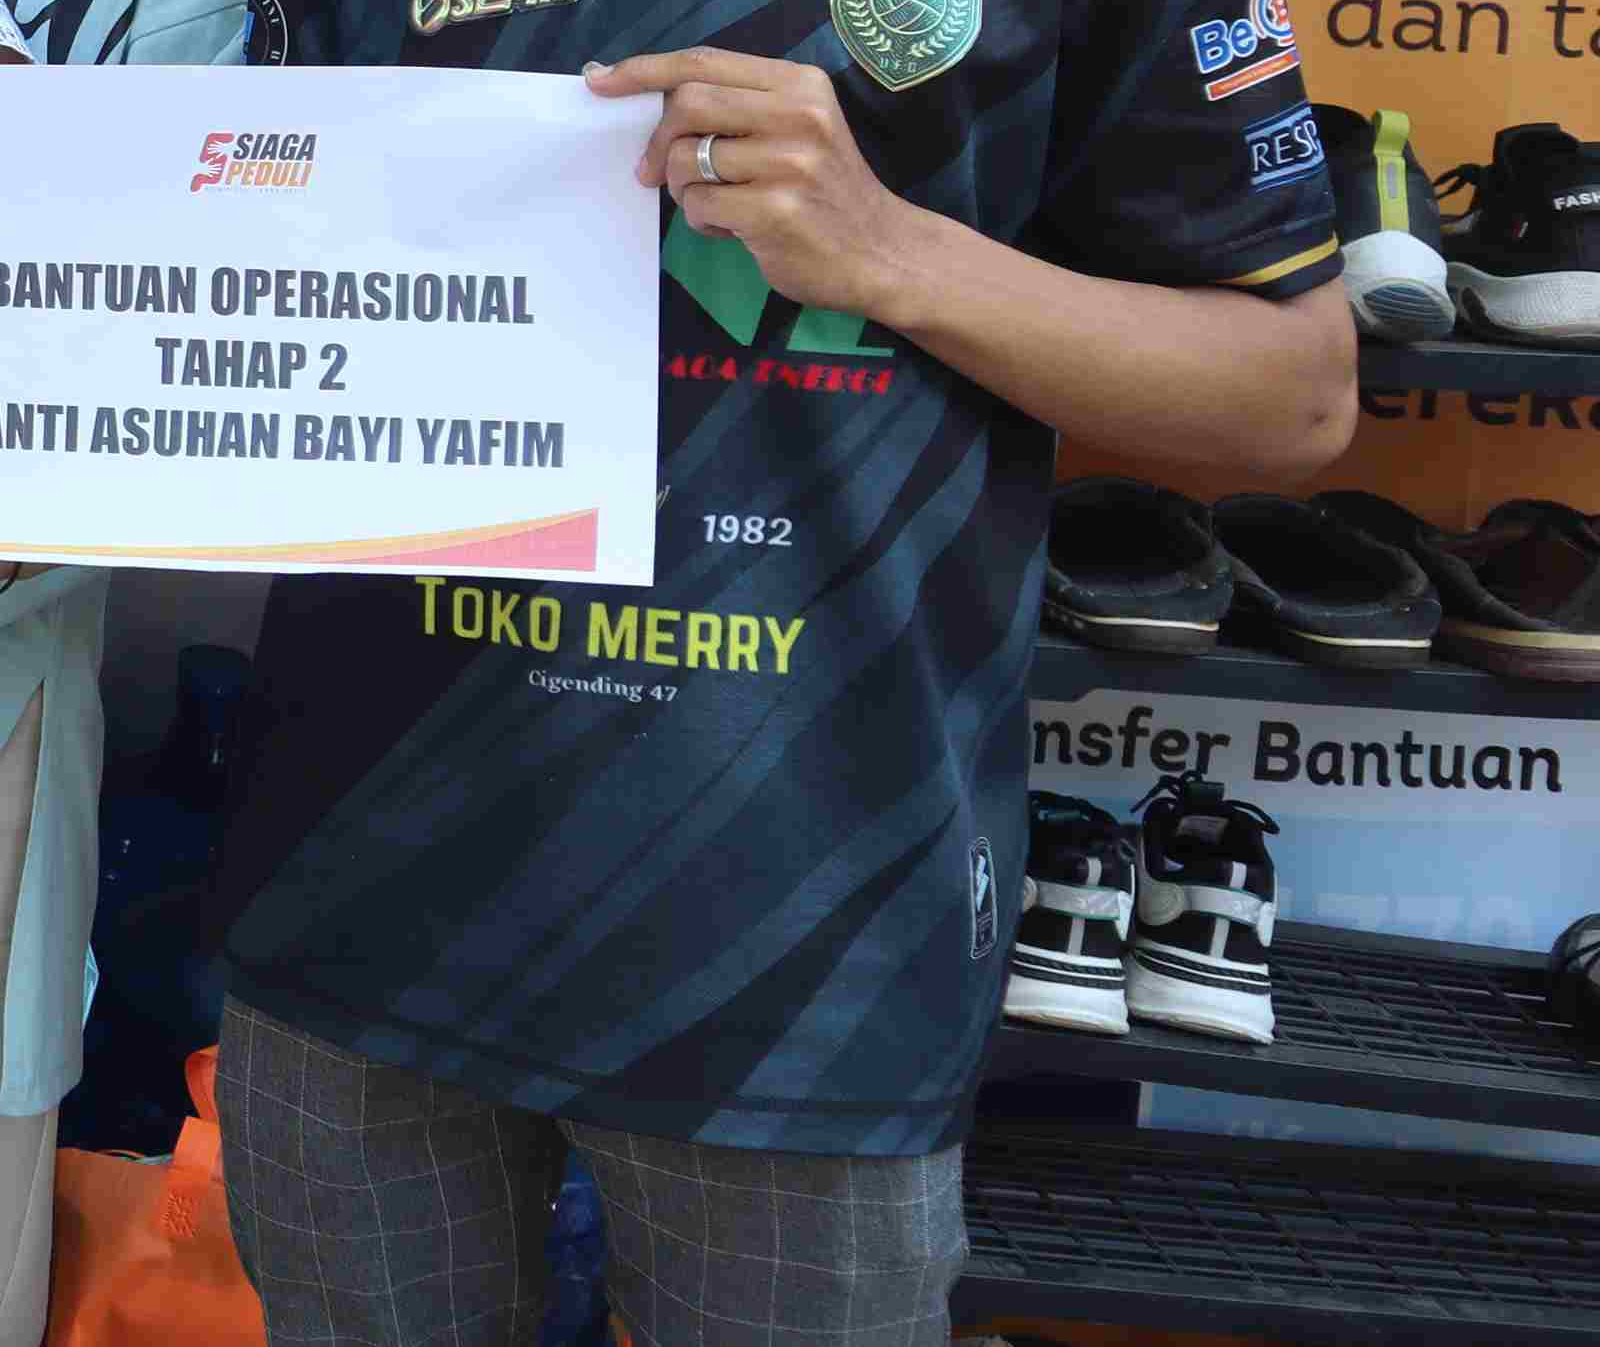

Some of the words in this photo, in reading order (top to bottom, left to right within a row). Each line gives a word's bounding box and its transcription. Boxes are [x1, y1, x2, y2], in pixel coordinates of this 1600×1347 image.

[233, 133, 317, 161] SIAGA
[1251, 119, 1319, 173] RESP
[225, 160, 312, 187] PEDULI
[211, 266, 535, 324] OPERASIONAL
[155, 337, 308, 390] TAHAP
[318, 342, 349, 391] 2
[88, 406, 281, 460] ASUHAN
[293, 413, 404, 464] BAYI
[416, 417, 566, 468] YAFIM
[703, 514, 793, 546] 1982
[415, 576, 563, 653] TOKO
[587, 601, 807, 675] MERRY
[528, 668, 643, 702] Cigending
[650, 683, 679, 702] 47
[1032, 706, 1231, 773] nsfer
[1253, 720, 1563, 794] Bantuan
